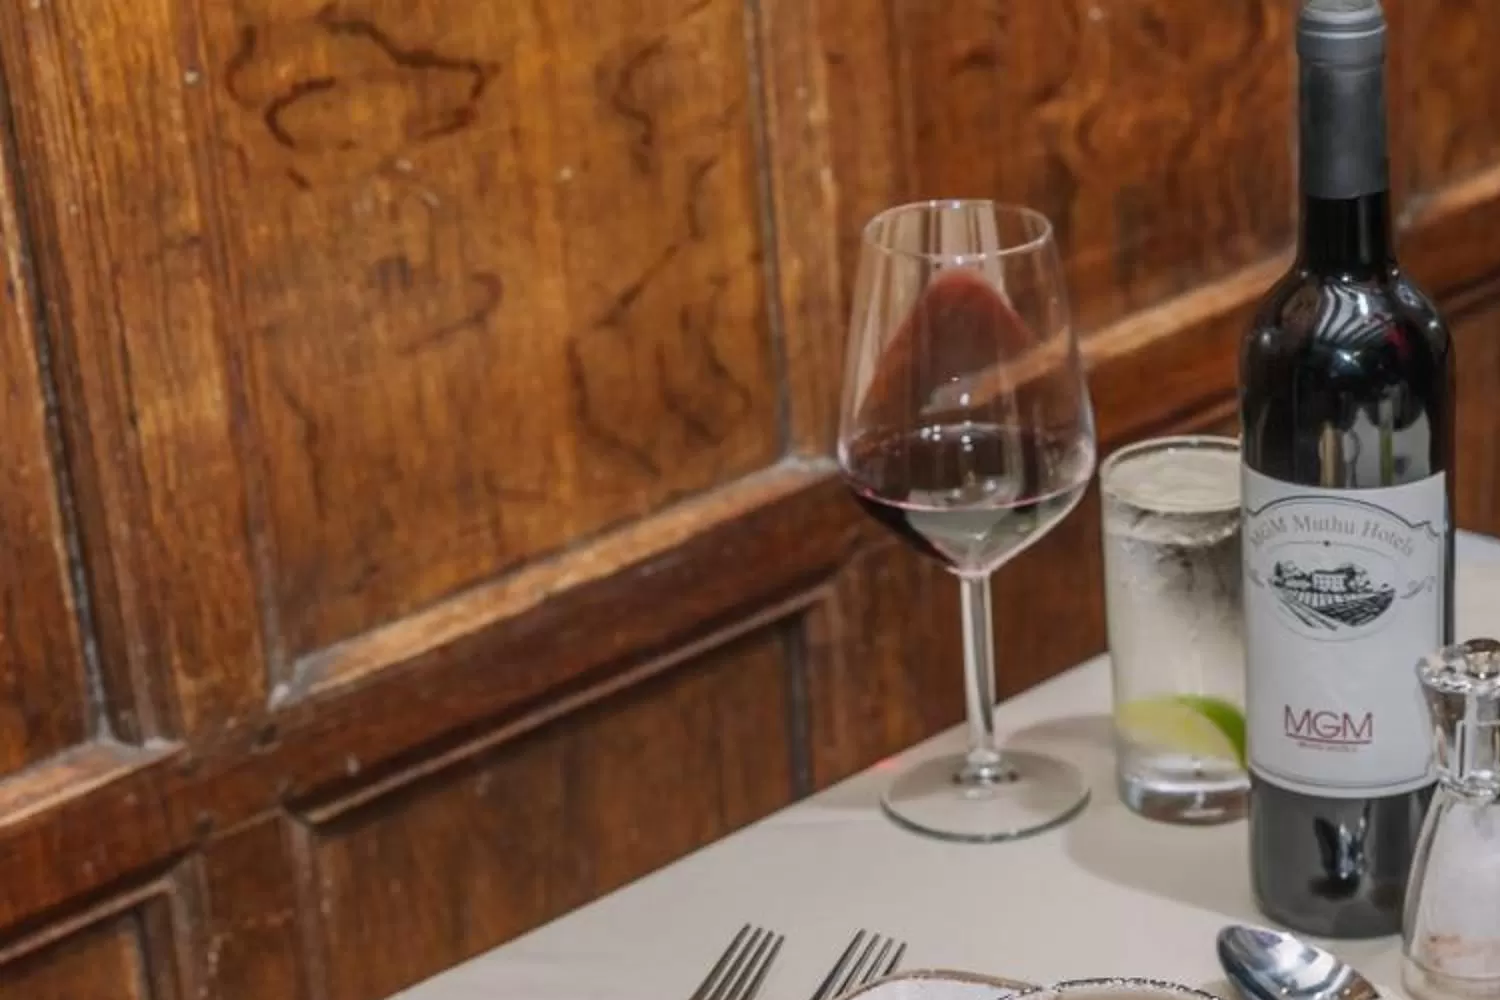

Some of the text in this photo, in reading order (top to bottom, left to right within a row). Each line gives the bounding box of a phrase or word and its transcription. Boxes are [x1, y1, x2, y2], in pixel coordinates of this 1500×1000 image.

[1291, 514, 1355, 536] Muthu
[1360, 518, 1414, 557] Hotels
[1284, 703, 1374, 739] MGM
